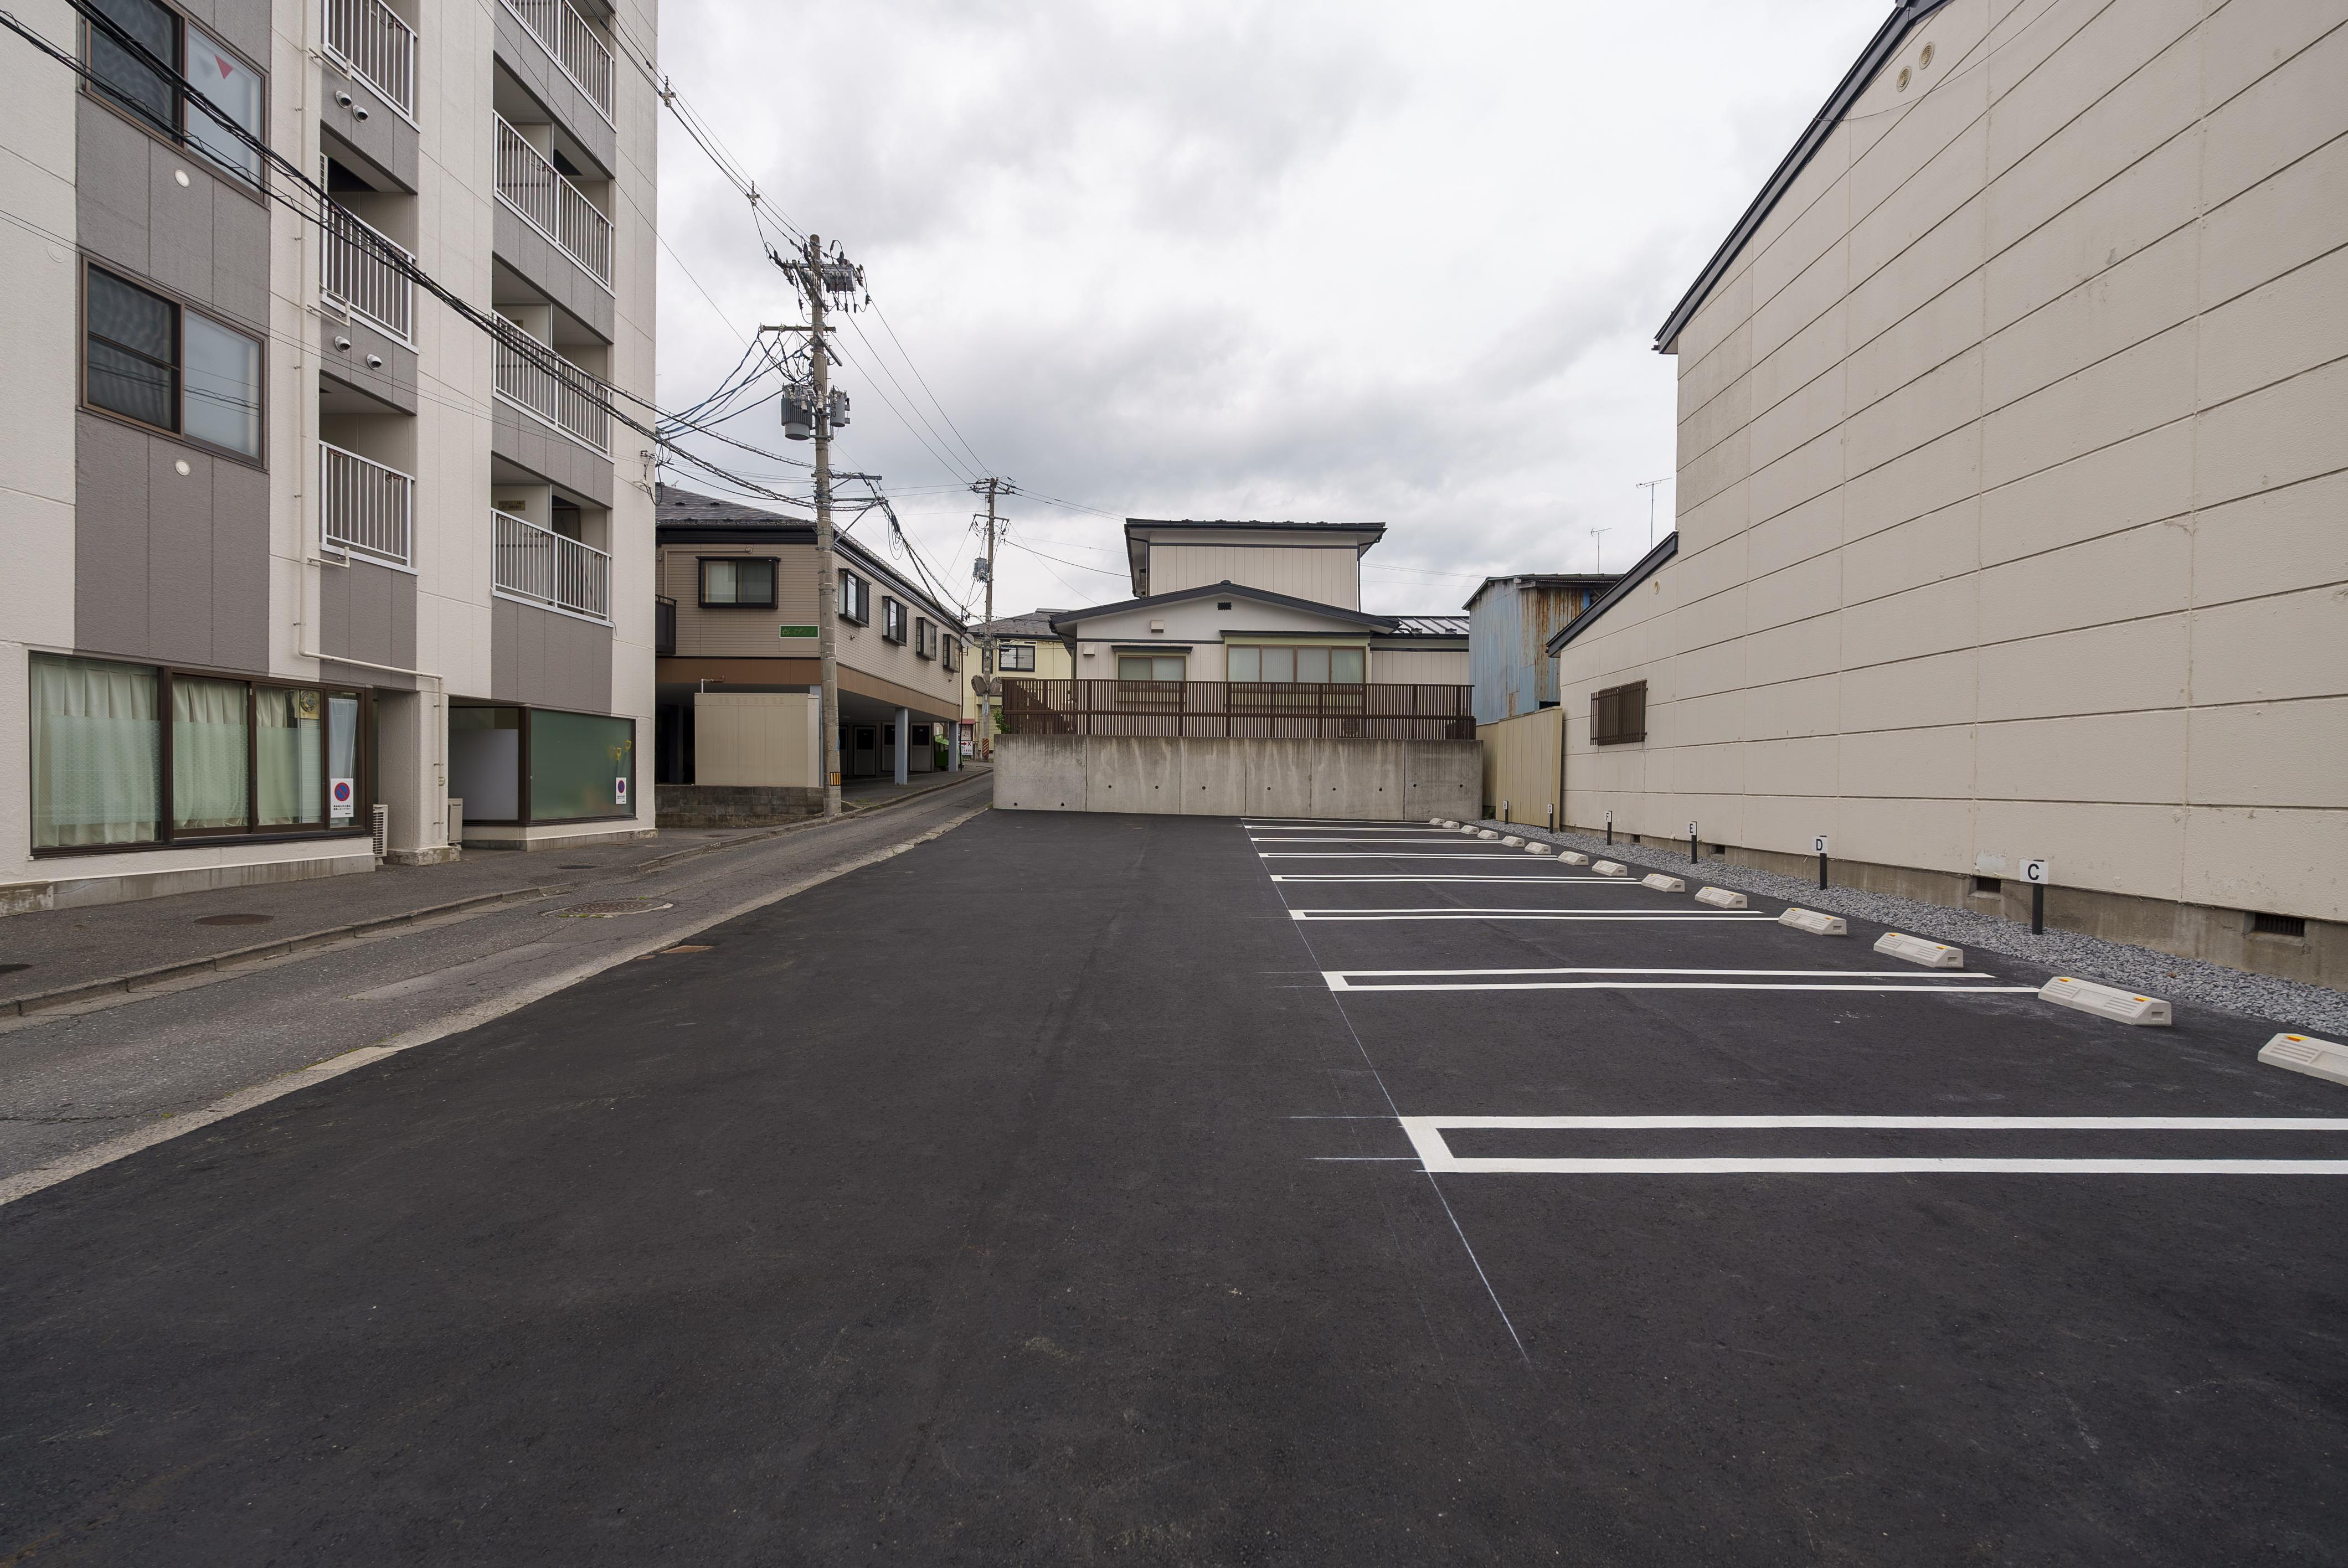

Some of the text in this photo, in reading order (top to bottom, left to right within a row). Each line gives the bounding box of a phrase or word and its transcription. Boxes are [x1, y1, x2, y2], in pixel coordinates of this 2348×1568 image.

[1690, 823, 1693, 833] E
[1816, 839, 1822, 850] D
[2028, 864, 2039, 880] C
